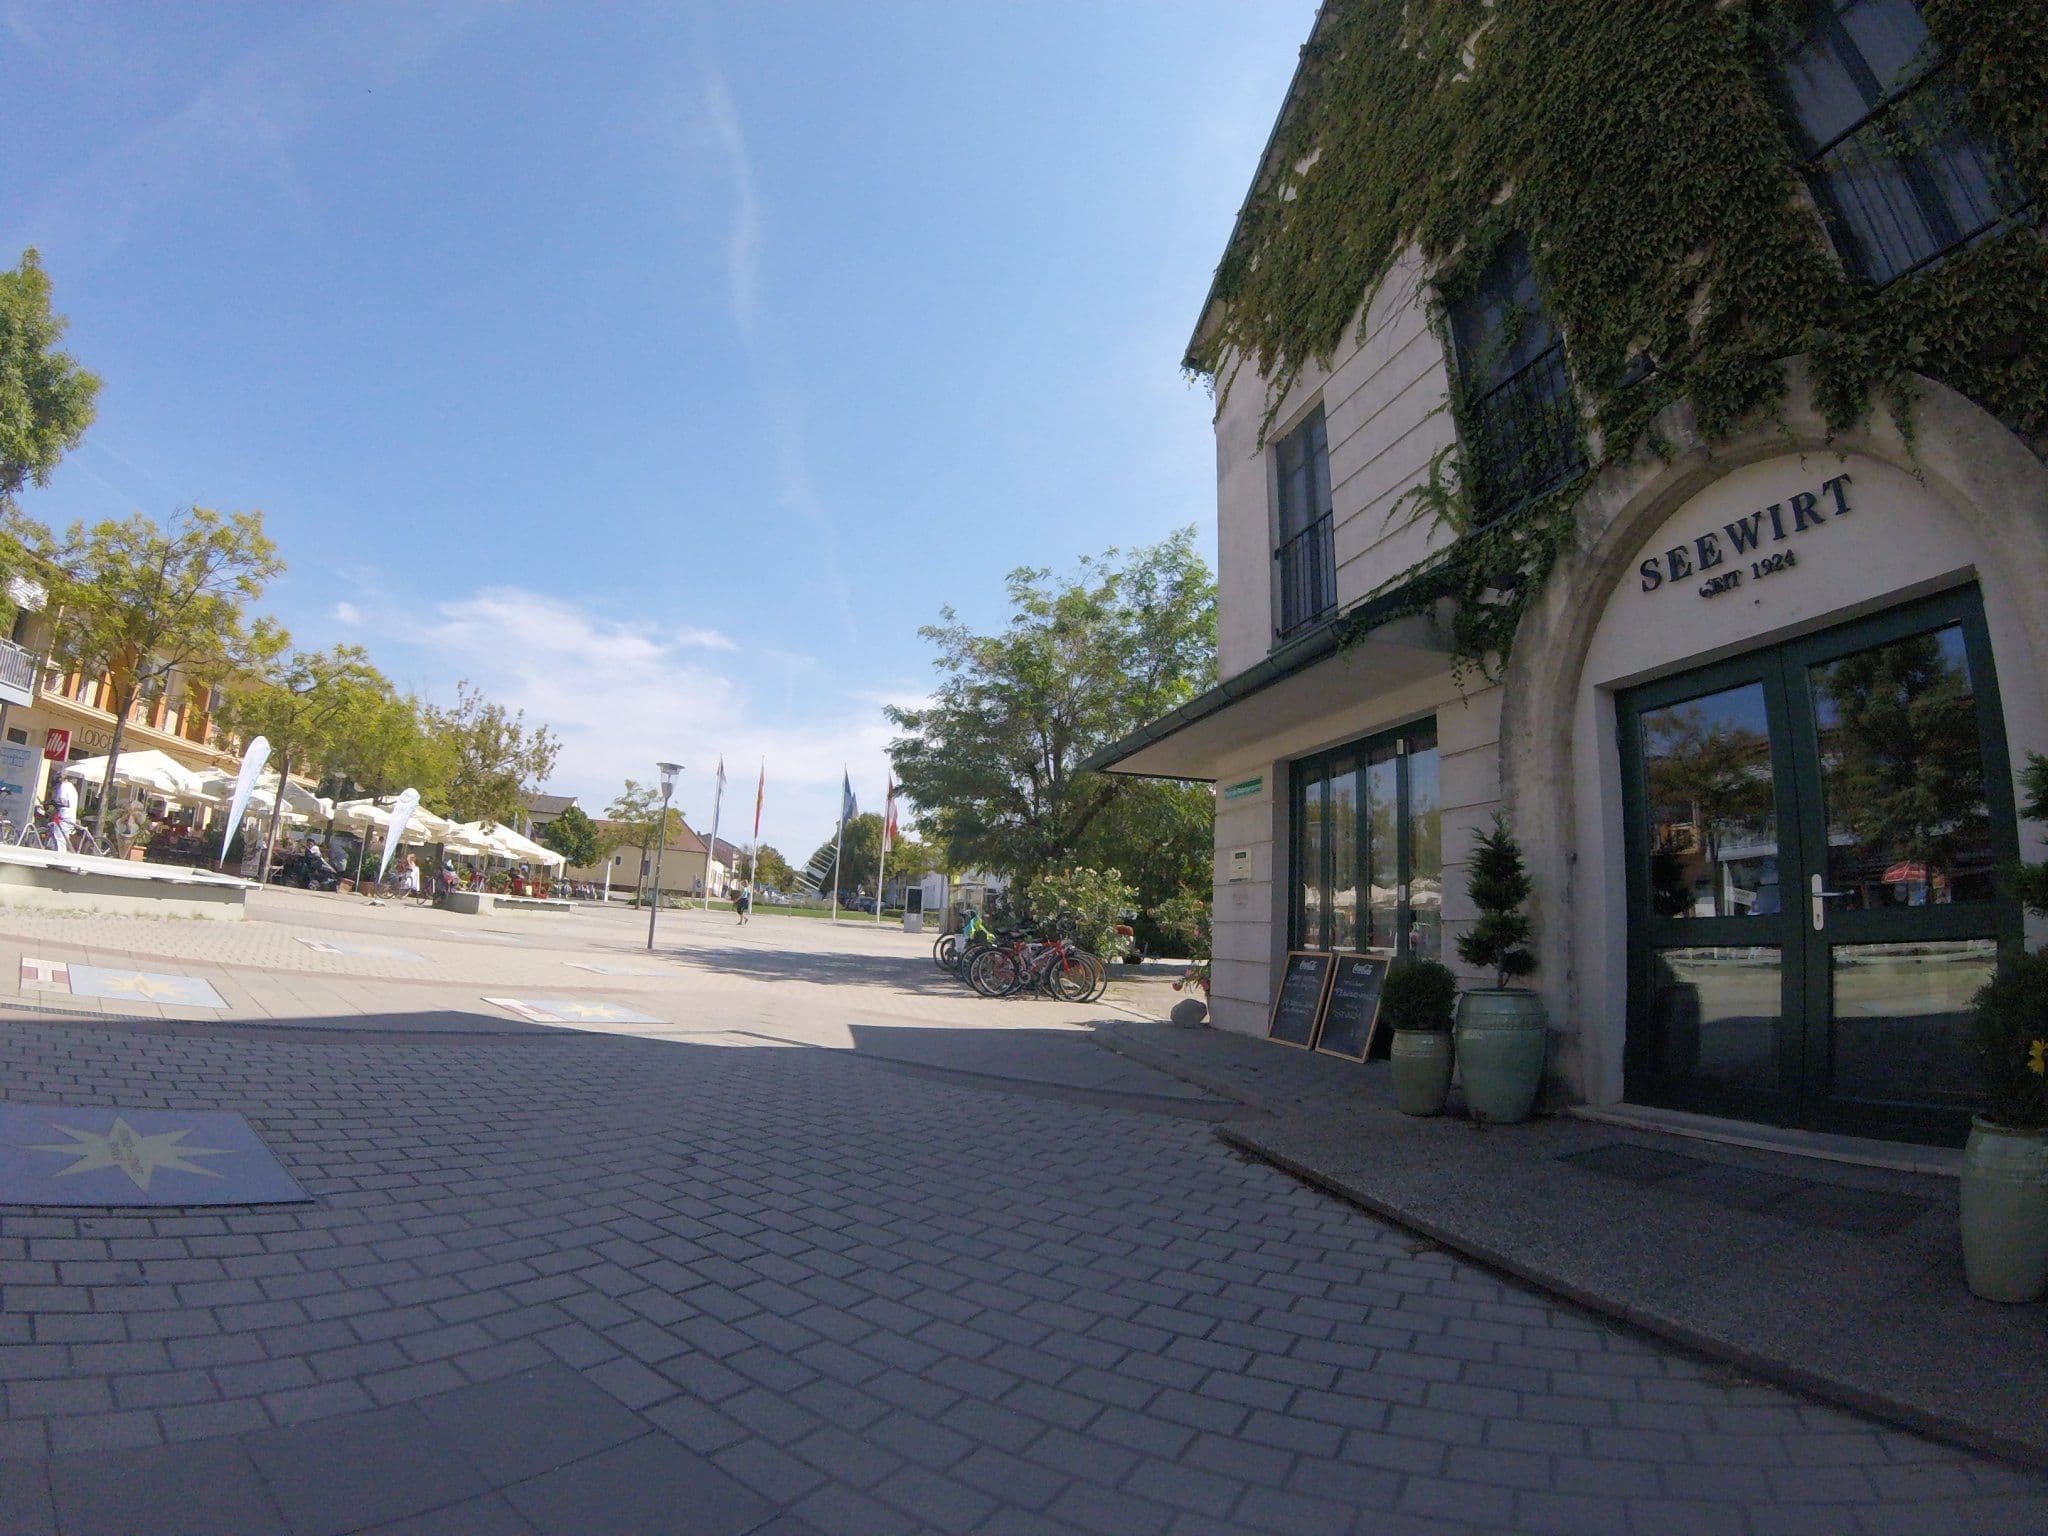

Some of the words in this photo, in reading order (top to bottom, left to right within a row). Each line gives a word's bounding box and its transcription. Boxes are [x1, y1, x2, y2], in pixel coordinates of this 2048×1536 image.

[1640, 473, 1852, 592] SEEWIRT
[1751, 549, 1797, 580] 1924
[46, 732, 66, 757] illy
